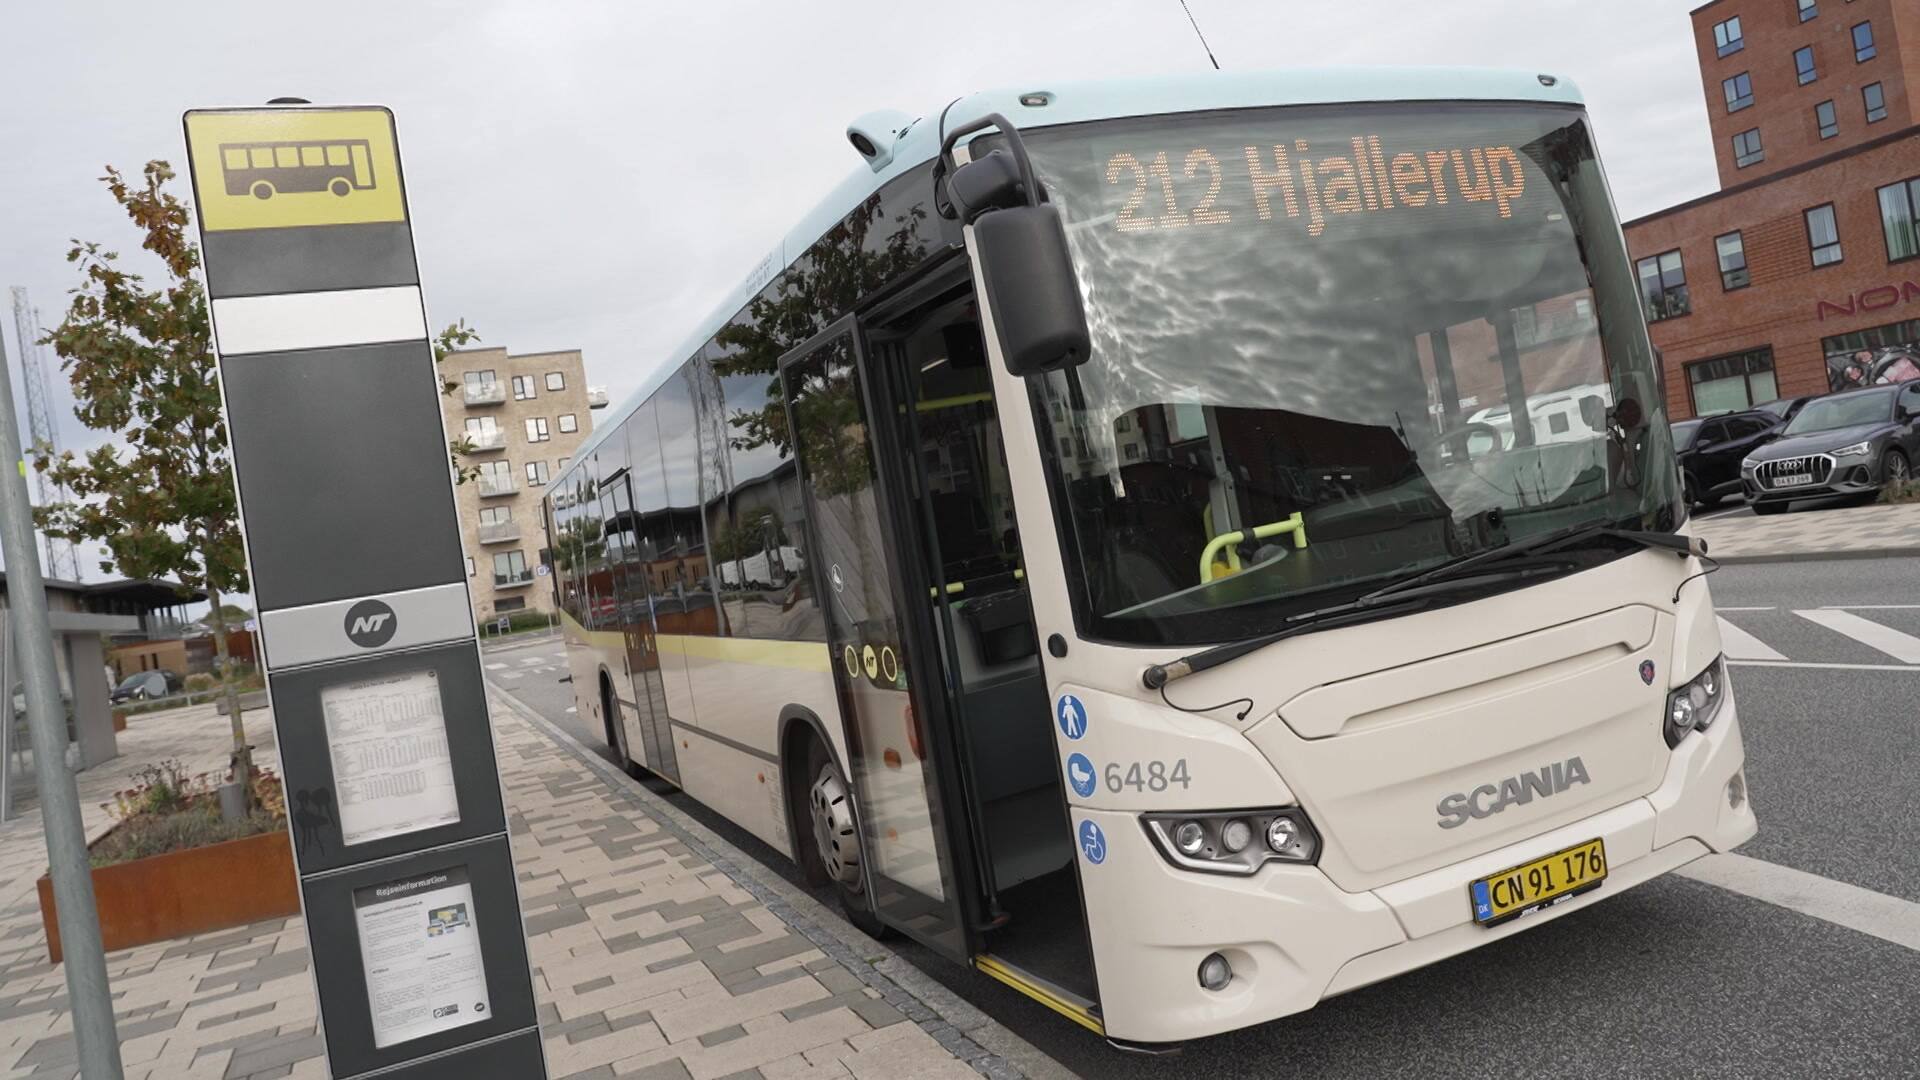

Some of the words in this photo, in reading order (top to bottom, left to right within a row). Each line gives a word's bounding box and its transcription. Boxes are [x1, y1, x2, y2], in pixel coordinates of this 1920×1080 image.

[1106, 149, 1231, 232] 212
[1245, 135, 1525, 236] Hjallerup
[350, 613, 391, 635] NT
[1104, 758, 1192, 794] 6484
[1436, 756, 1591, 829] SCANIA
[376, 874, 447, 897] Rejseinformation
[1492, 873, 1525, 908] CN
[1528, 863, 1555, 896] 91
[1563, 846, 1602, 884] 176
[1478, 903, 1489, 914] DK
